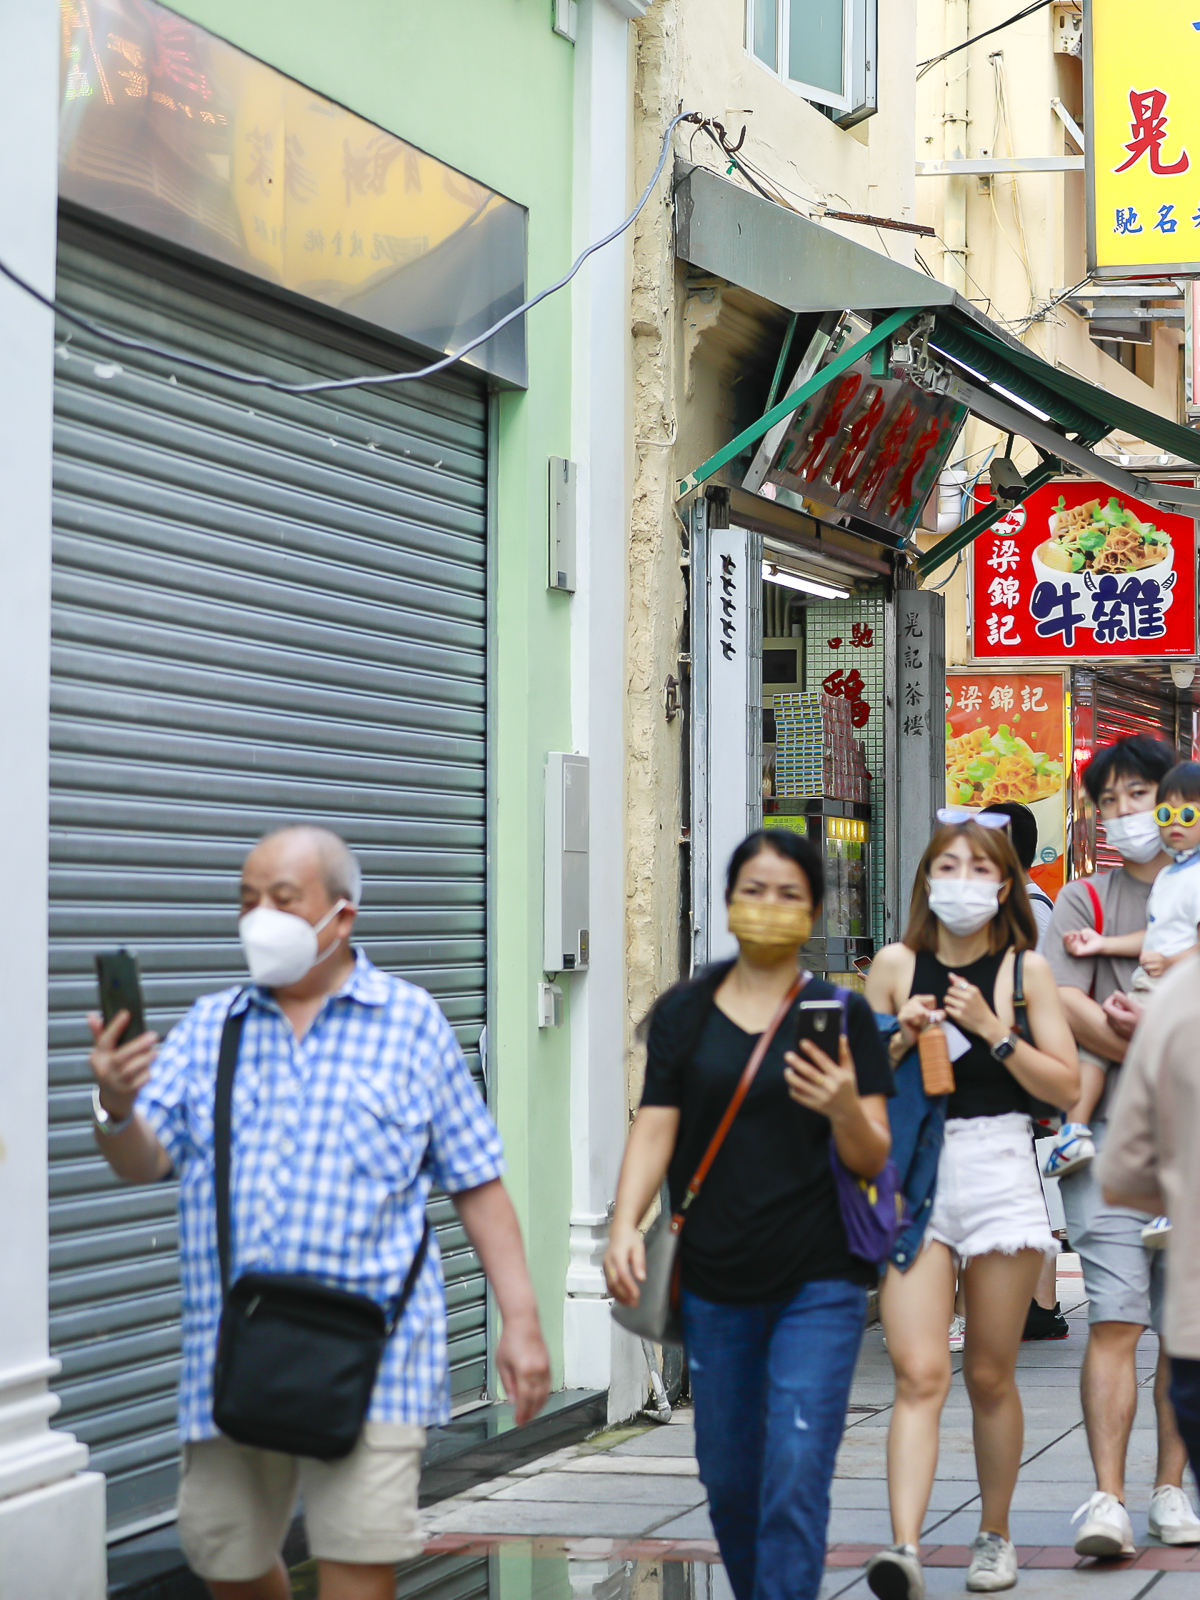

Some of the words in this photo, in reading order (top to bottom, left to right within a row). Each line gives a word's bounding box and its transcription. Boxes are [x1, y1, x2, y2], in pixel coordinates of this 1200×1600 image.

[986, 539, 1021, 646] 梁錦記
[903, 612, 925, 737] 晃記茶樓
[957, 685, 1049, 713] 梁錦記
